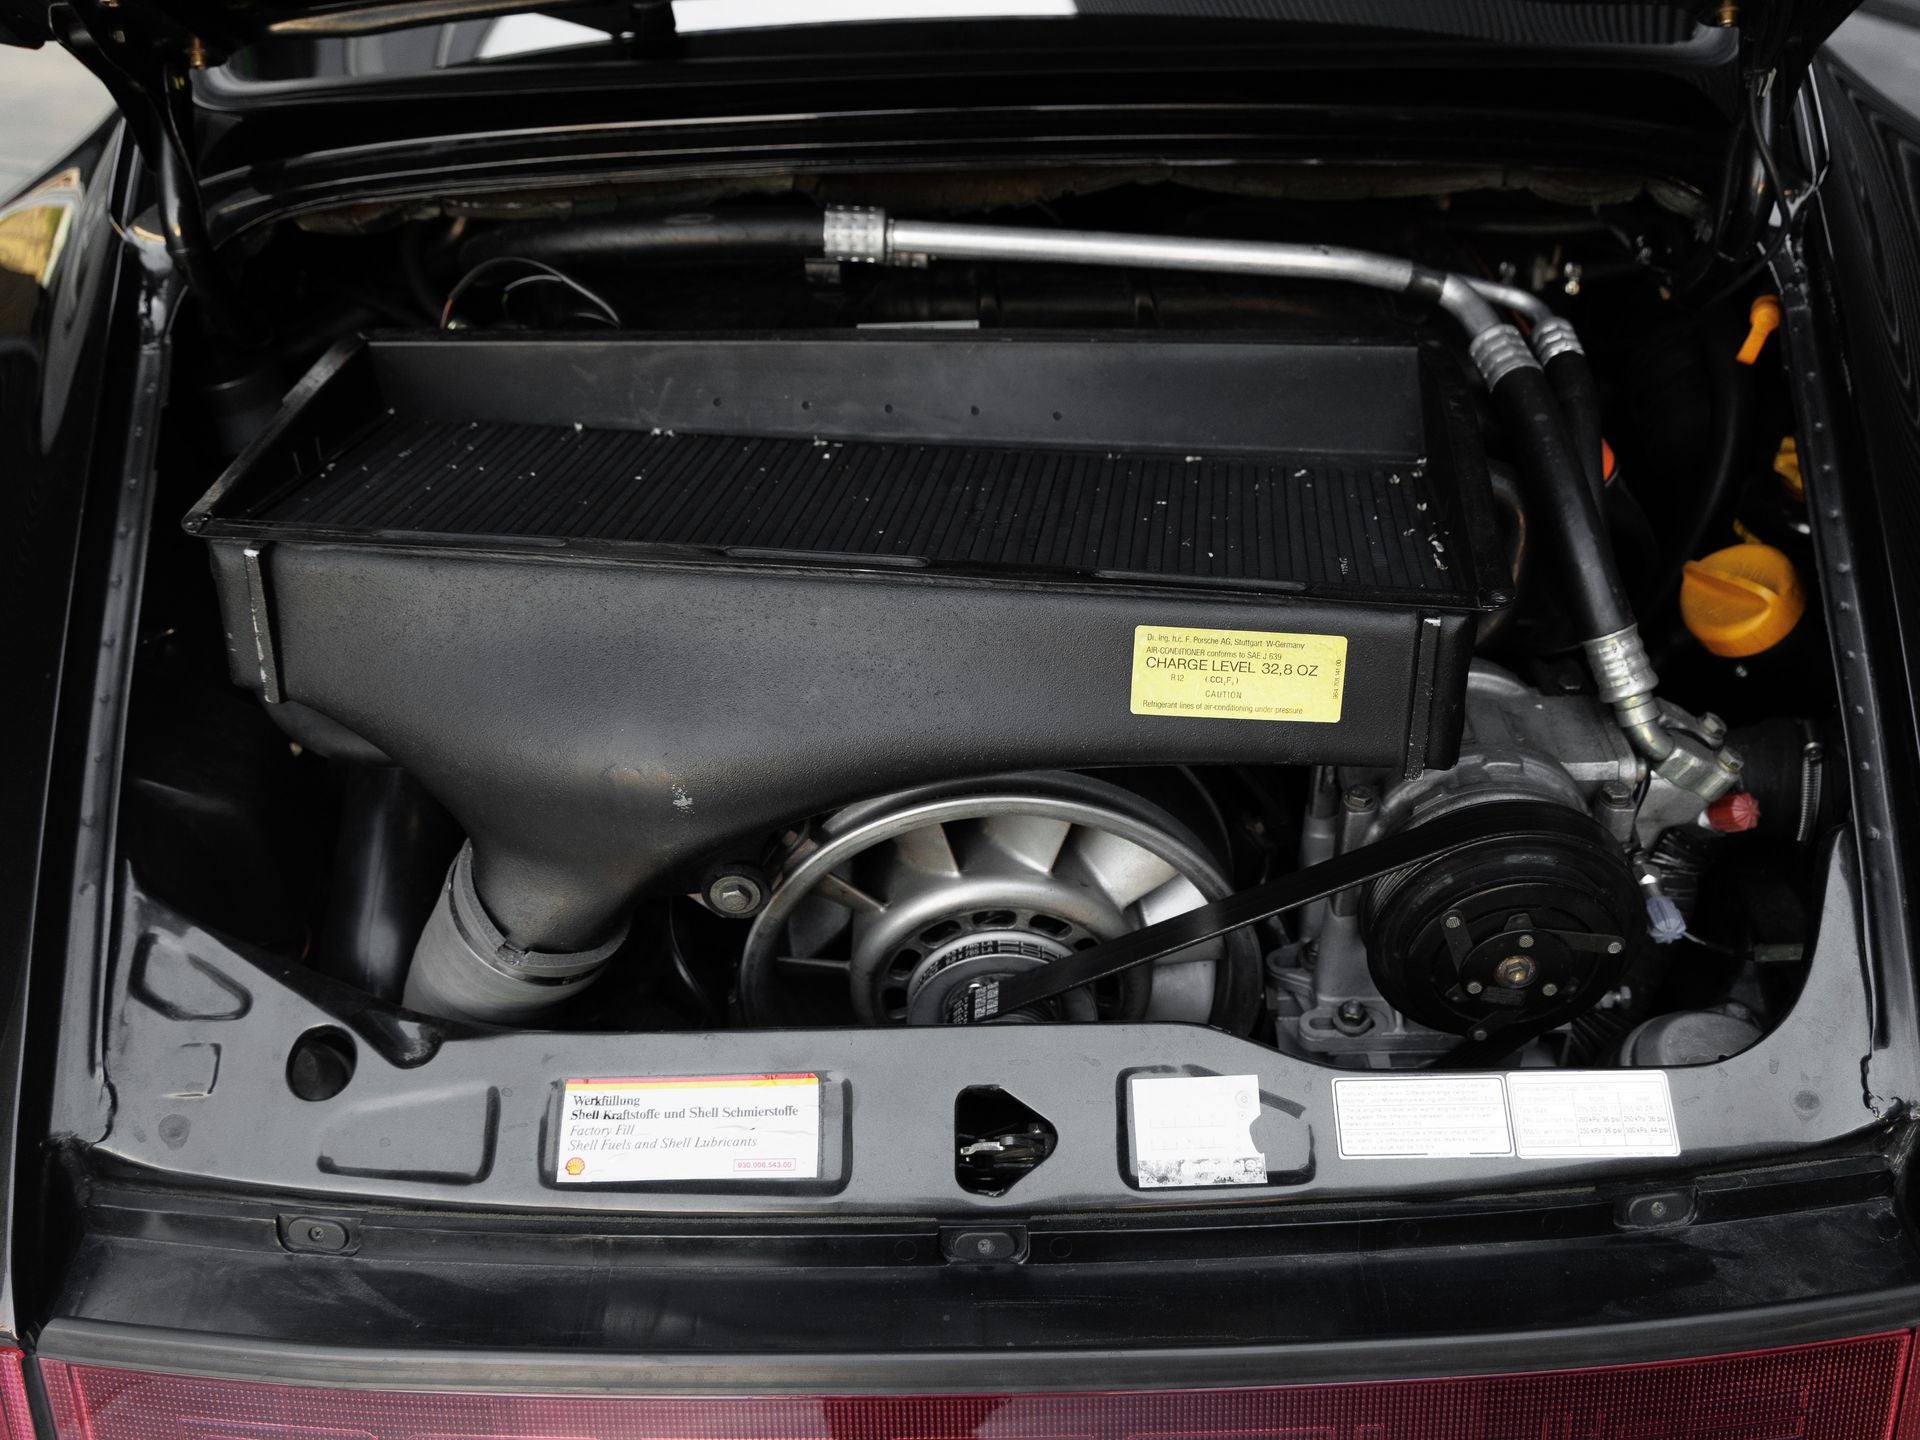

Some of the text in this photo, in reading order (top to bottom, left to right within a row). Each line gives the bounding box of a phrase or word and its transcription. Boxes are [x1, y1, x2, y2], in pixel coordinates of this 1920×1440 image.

[1158, 634, 1170, 643] Ing.
[1193, 636, 1219, 644] Porsche
[1220, 637, 1233, 646] AG,
[1234, 638, 1262, 647] Stuttgart
[1266, 640, 1305, 649] W-Germany
[1146, 646, 1205, 656] AIR-CONDITIONER
[1207, 649, 1237, 658] conforms
[1146, 656, 1318, 676] CHARGE LEVEL 32,8 OZ
[1205, 690, 1242, 699] CAUTION
[1143, 700, 1178, 709] Refrigerant
[1204, 703, 1253, 713] air-conditioning
[573, 1094, 640, 1108] Werkfüllung
[570, 1105, 799, 1121] Shell Kraftstoffe und Shell Schmierstoffe
[569, 1124, 636, 1137] Factory Fill
[568, 1136, 758, 1152] Shell Fuels and Shell Lubricants
